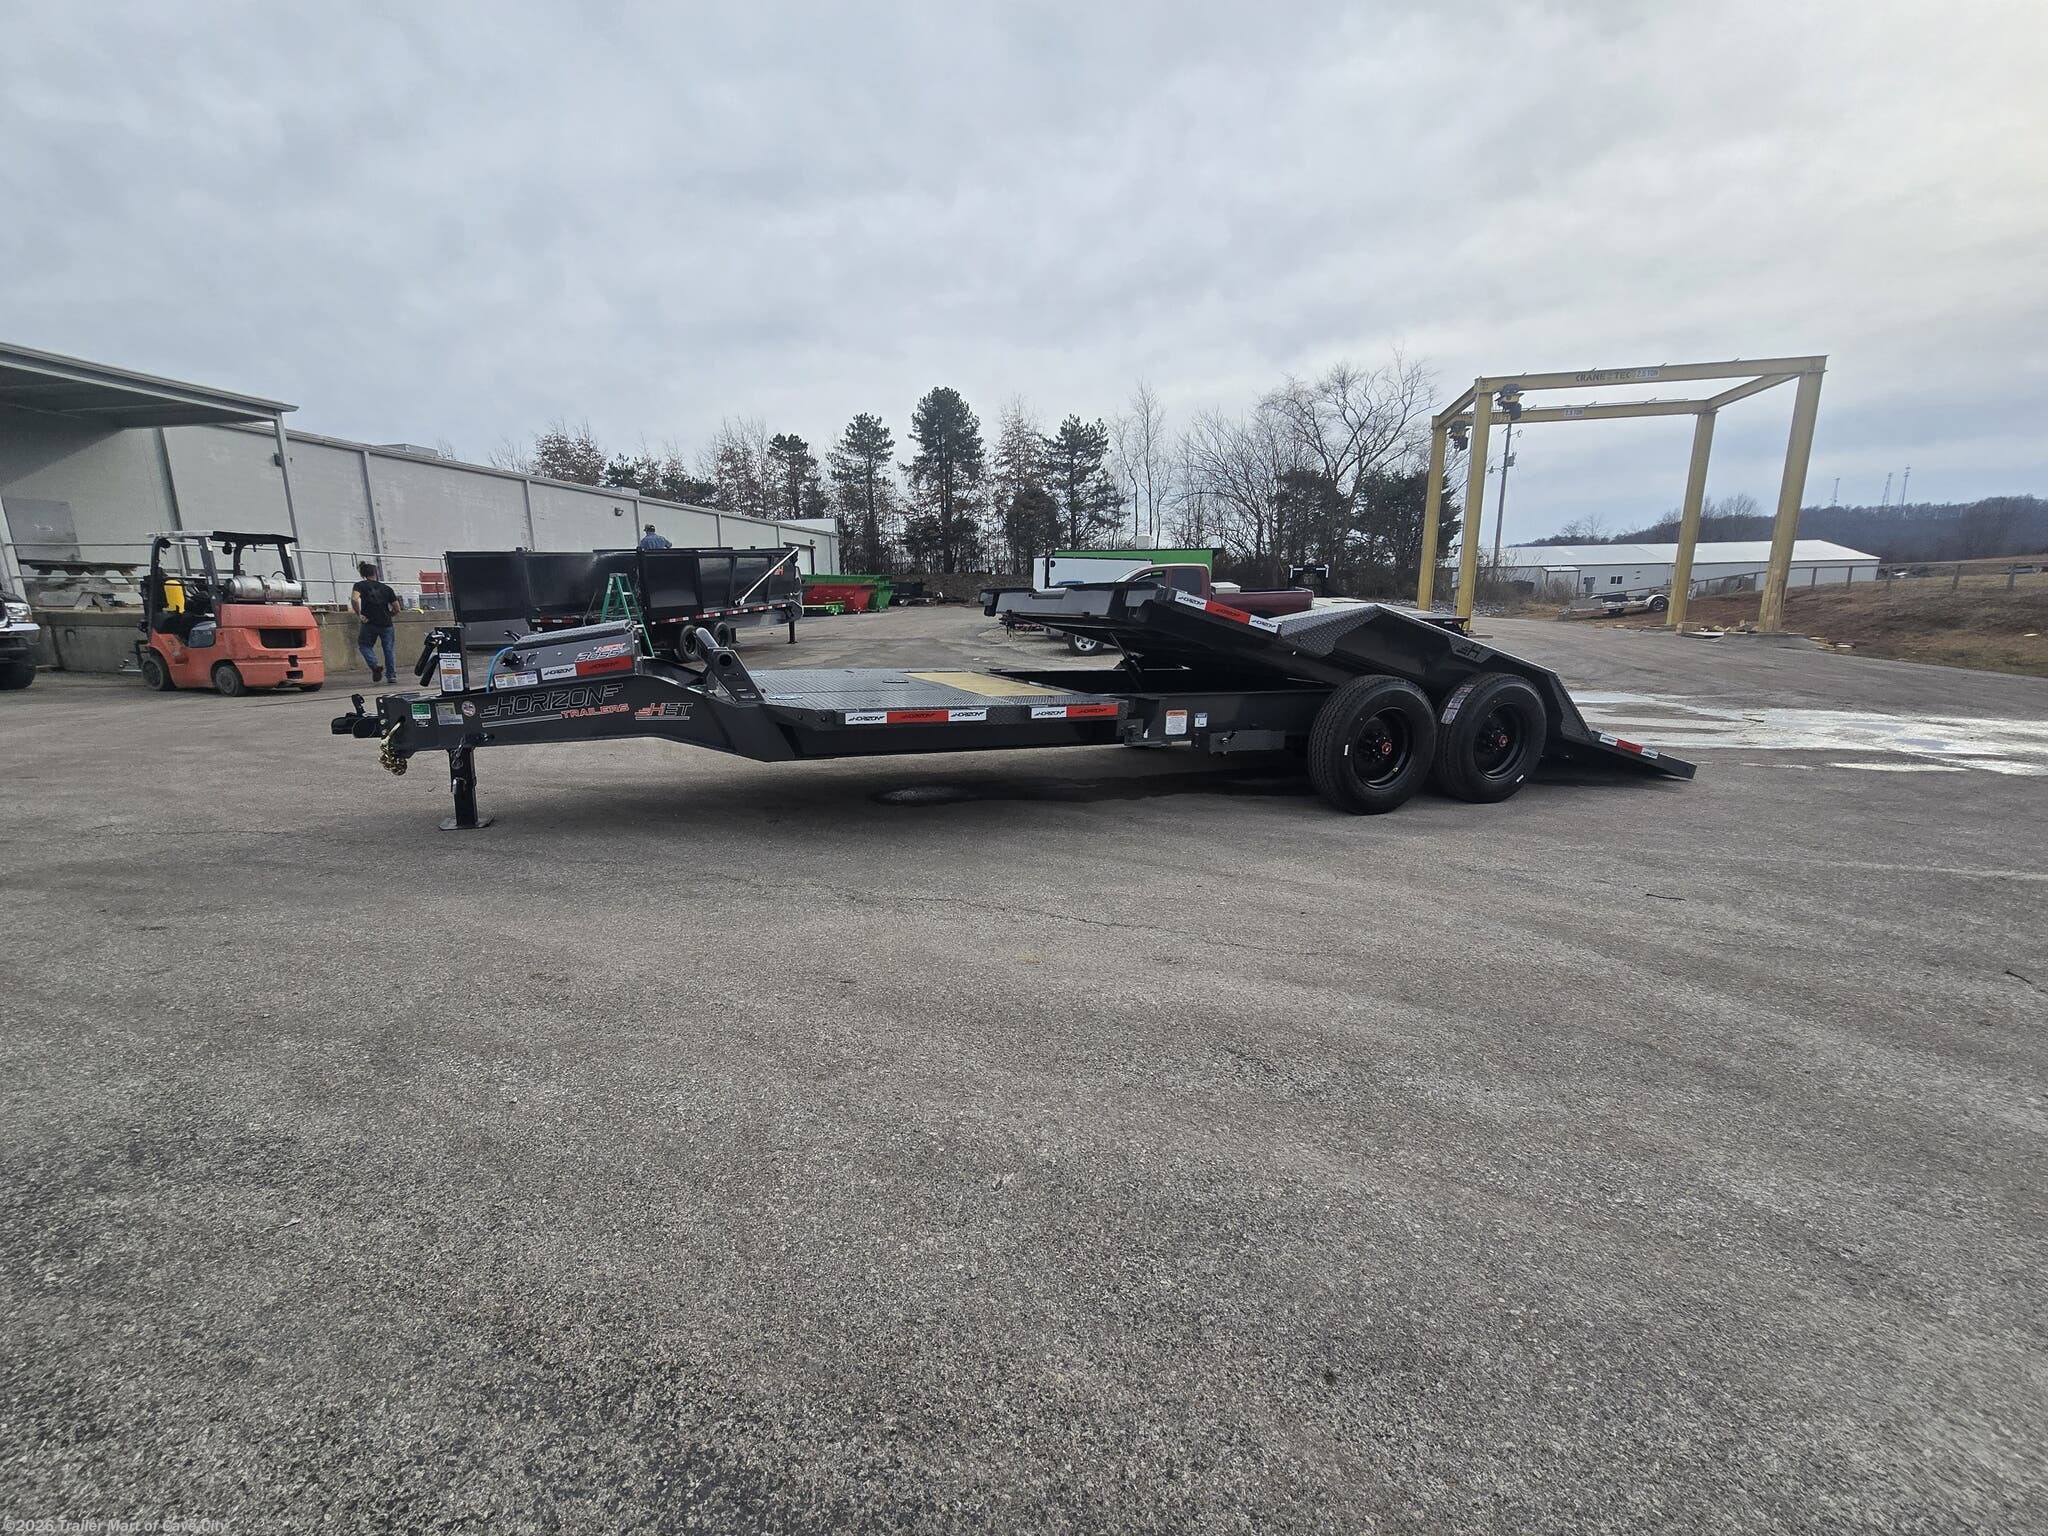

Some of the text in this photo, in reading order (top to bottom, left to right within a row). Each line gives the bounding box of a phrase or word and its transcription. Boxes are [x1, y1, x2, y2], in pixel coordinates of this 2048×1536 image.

[545, 666, 574, 676] HORIZON
[486, 683, 617, 718] HORIZON
[561, 703, 630, 719] TRAILERS
